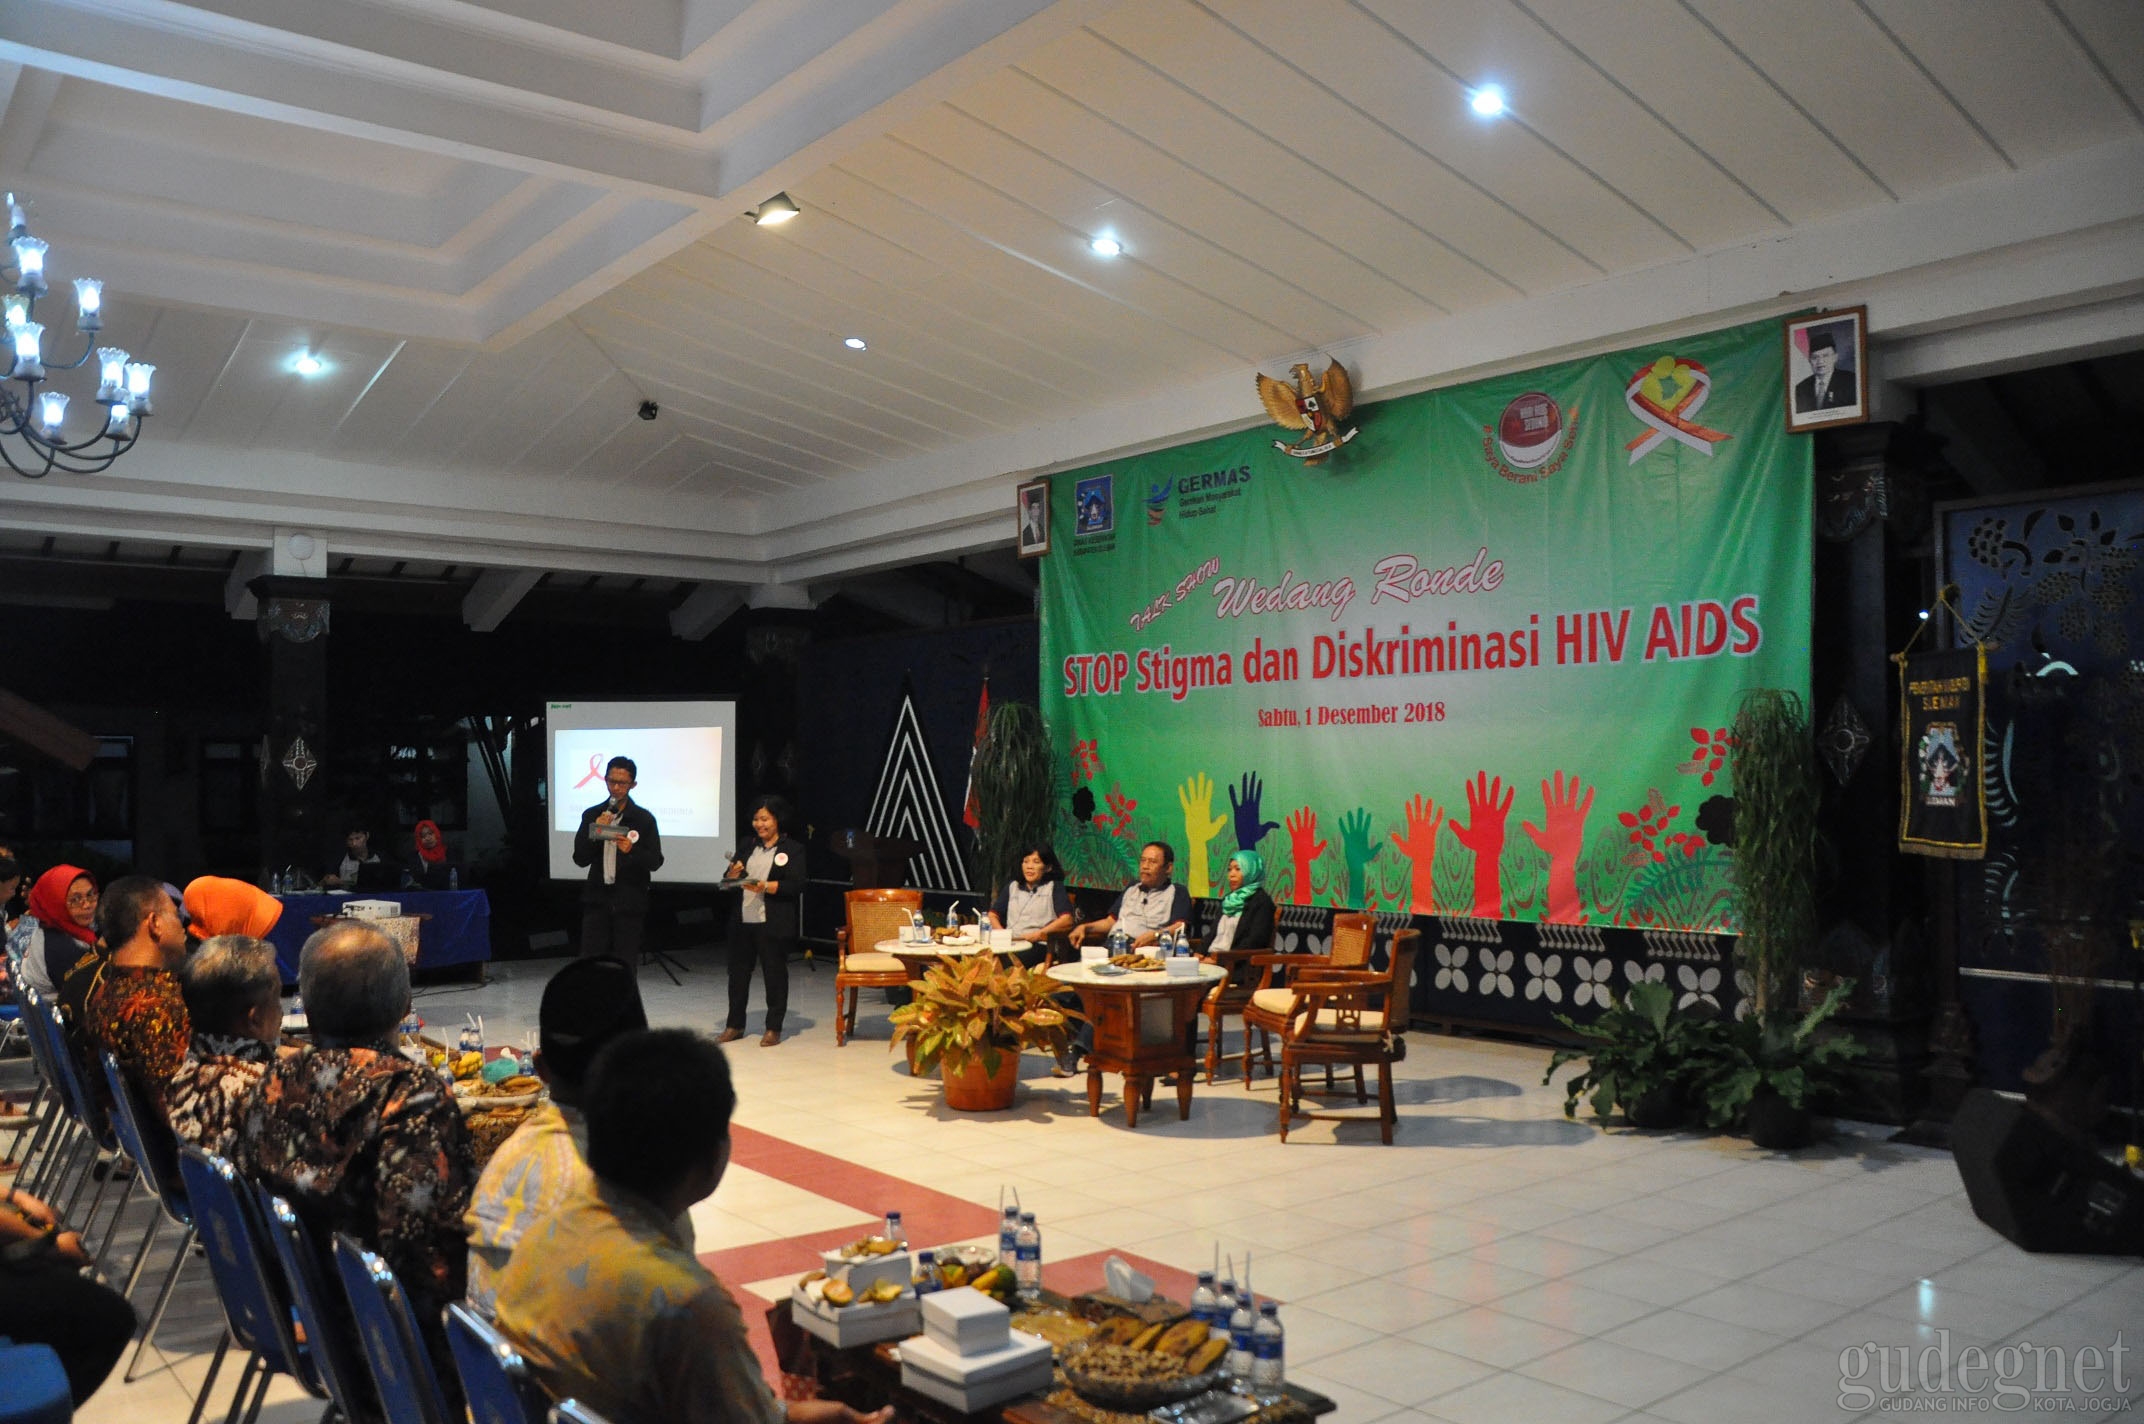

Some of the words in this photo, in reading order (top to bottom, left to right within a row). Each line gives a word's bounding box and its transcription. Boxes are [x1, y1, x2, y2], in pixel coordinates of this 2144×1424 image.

[1178, 465, 1251, 494] GERMAS
[1498, 464, 1537, 482] Berani
[1540, 452, 1568, 478] Saya
[1130, 591, 1172, 631] TALK
[1175, 556, 1221, 603] SHOW
[1212, 570, 1357, 621] Wedang
[1371, 546, 1505, 604] Ronde
[1064, 652, 1128, 696] STOP
[1136, 645, 1232, 701] Stigma
[1243, 637, 1299, 684] dan
[1312, 614, 1540, 679] Diskriminasi
[1556, 609, 1631, 665] HIV
[1644, 596, 1761, 662] AIDS
[1258, 706, 1302, 728] Sabtu,
[1305, 706, 1313, 725] 1
[1318, 704, 1399, 726] Desember
[1404, 701, 1446, 723] 2018
